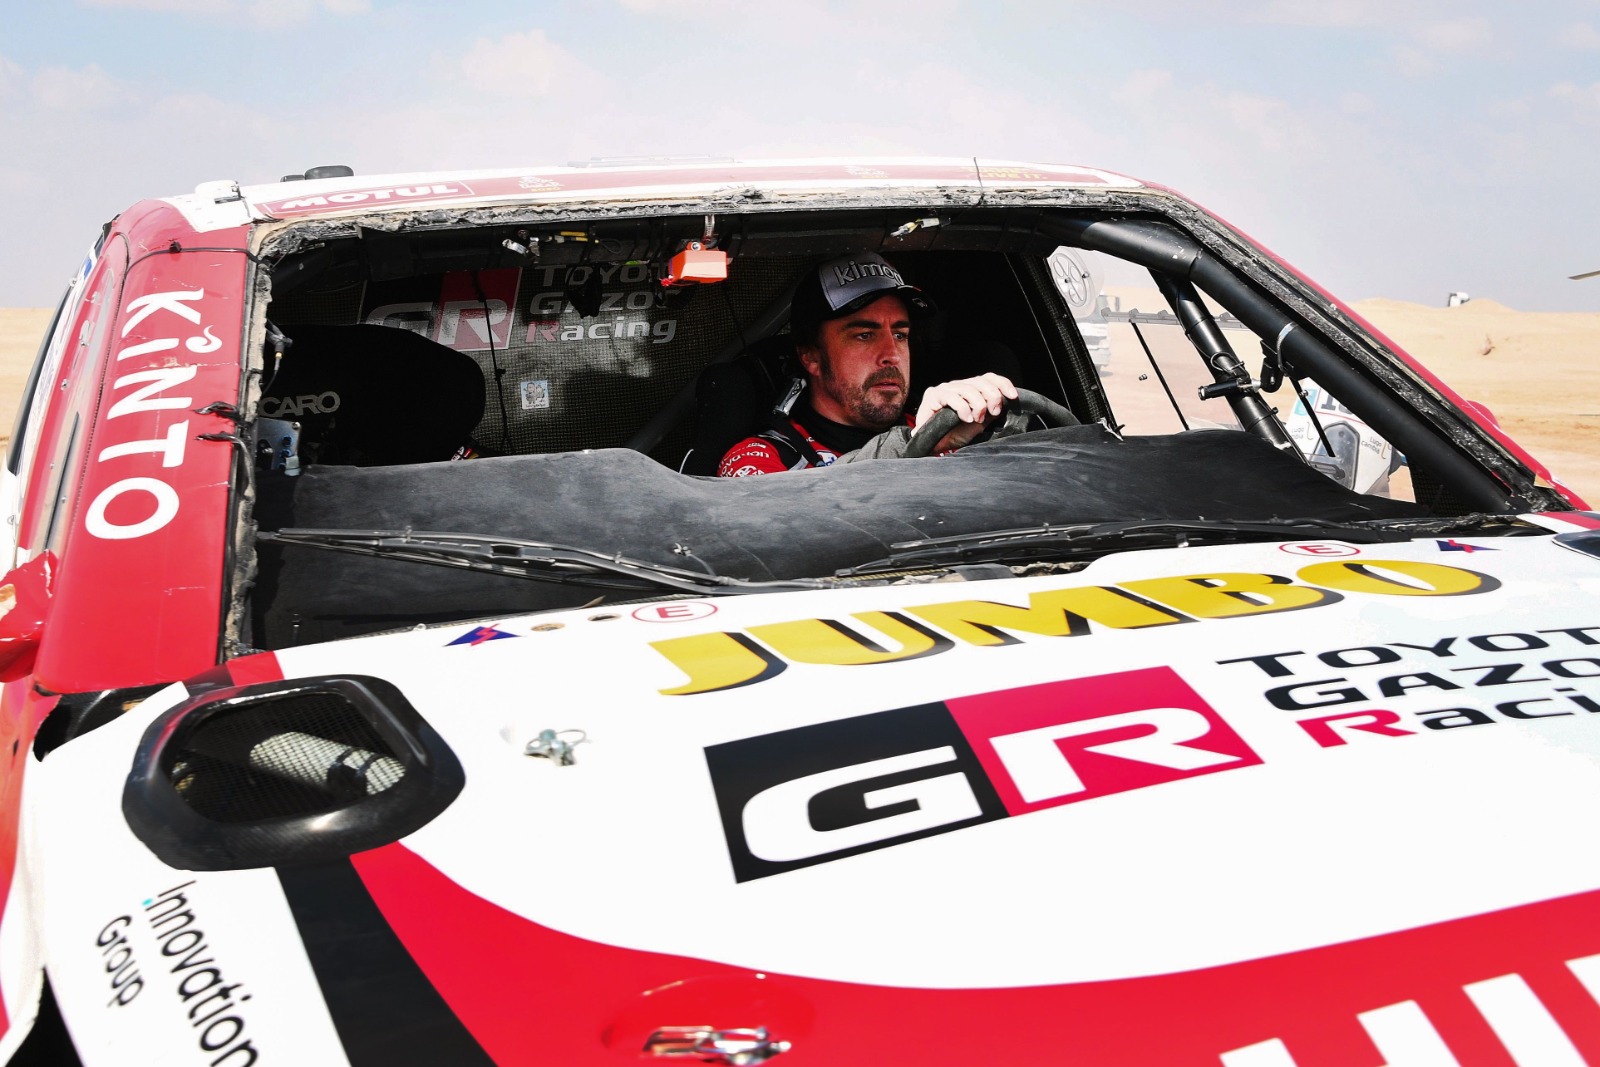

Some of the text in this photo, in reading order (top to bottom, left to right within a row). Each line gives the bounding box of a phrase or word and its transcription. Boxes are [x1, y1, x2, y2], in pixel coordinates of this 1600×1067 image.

[281, 184, 459, 209] MOTUL
[366, 299, 508, 345] GR
[529, 291, 682, 315] GZO
[525, 316, 677, 344] Racing
[649, 559, 1502, 696] JUMBO
[742, 707, 1244, 862] GR
[96, 915, 144, 1008] Group
